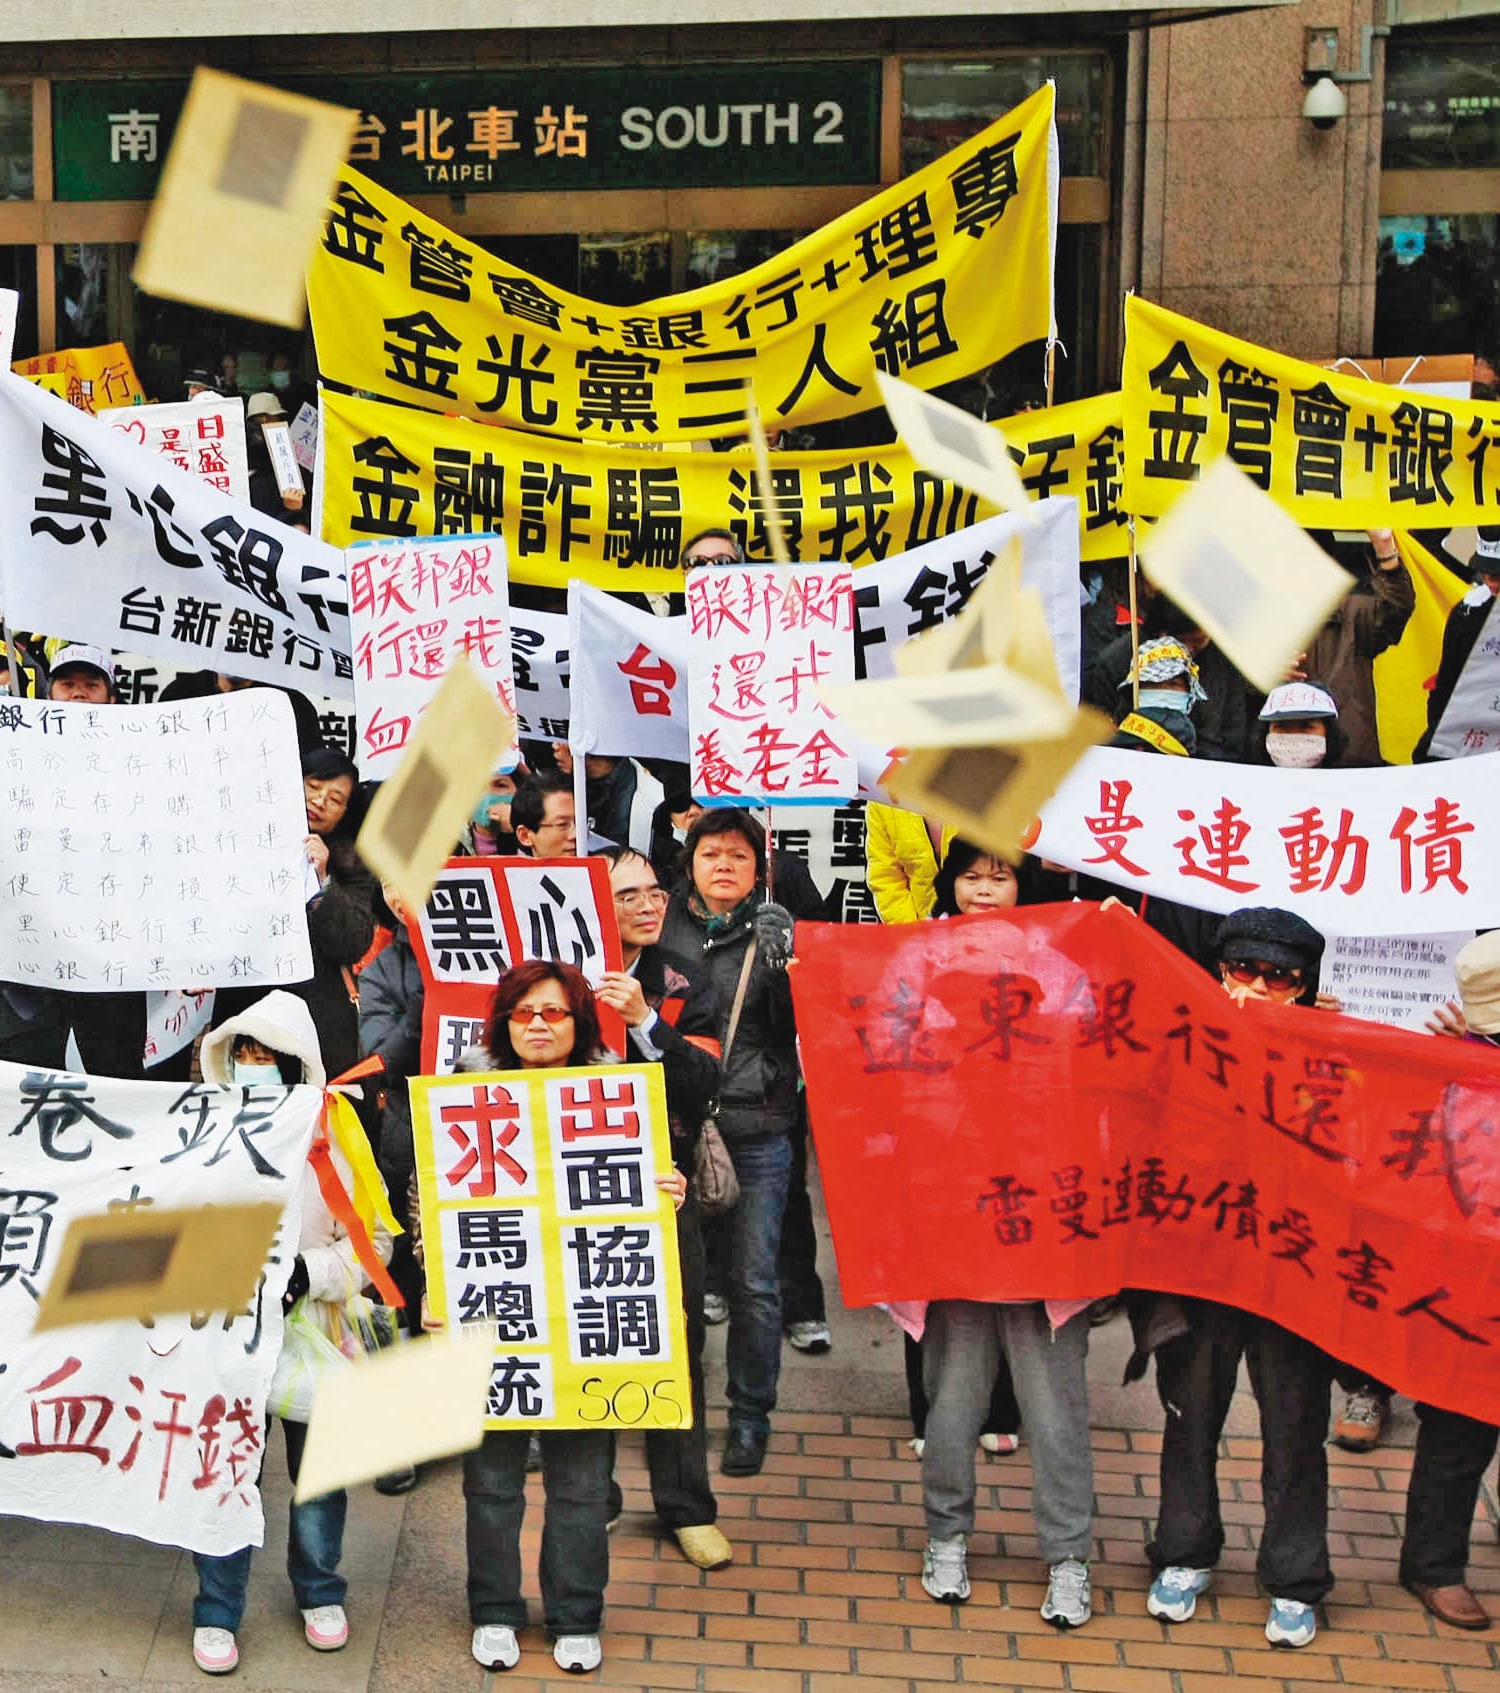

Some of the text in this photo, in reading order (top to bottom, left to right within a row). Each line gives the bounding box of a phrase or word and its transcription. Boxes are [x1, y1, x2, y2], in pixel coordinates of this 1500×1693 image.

[107, 109, 160, 163] 南
[349, 103, 588, 161] 台北車站
[424, 164, 494, 183] TAIPEI
[619, 101, 845, 152] SOUTH 2
[320, 131, 1022, 352] 金管會+銀行+理專
[382, 279, 959, 434] 金光黨三人組
[350, 436, 682, 570] 金融詐騙
[691, 722, 850, 797] 養老金
[1081, 779, 1476, 896] 曼連動債
[425, 874, 596, 973] 黑心
[850, 973, 1488, 1219] 遠東銀行還我
[439, 1084, 544, 1418] 求馬總統
[560, 1077, 662, 1359] 出面協調
[977, 1156, 1492, 1346] 雷曼連動債受害人
[577, 1377, 684, 1427] SOS
